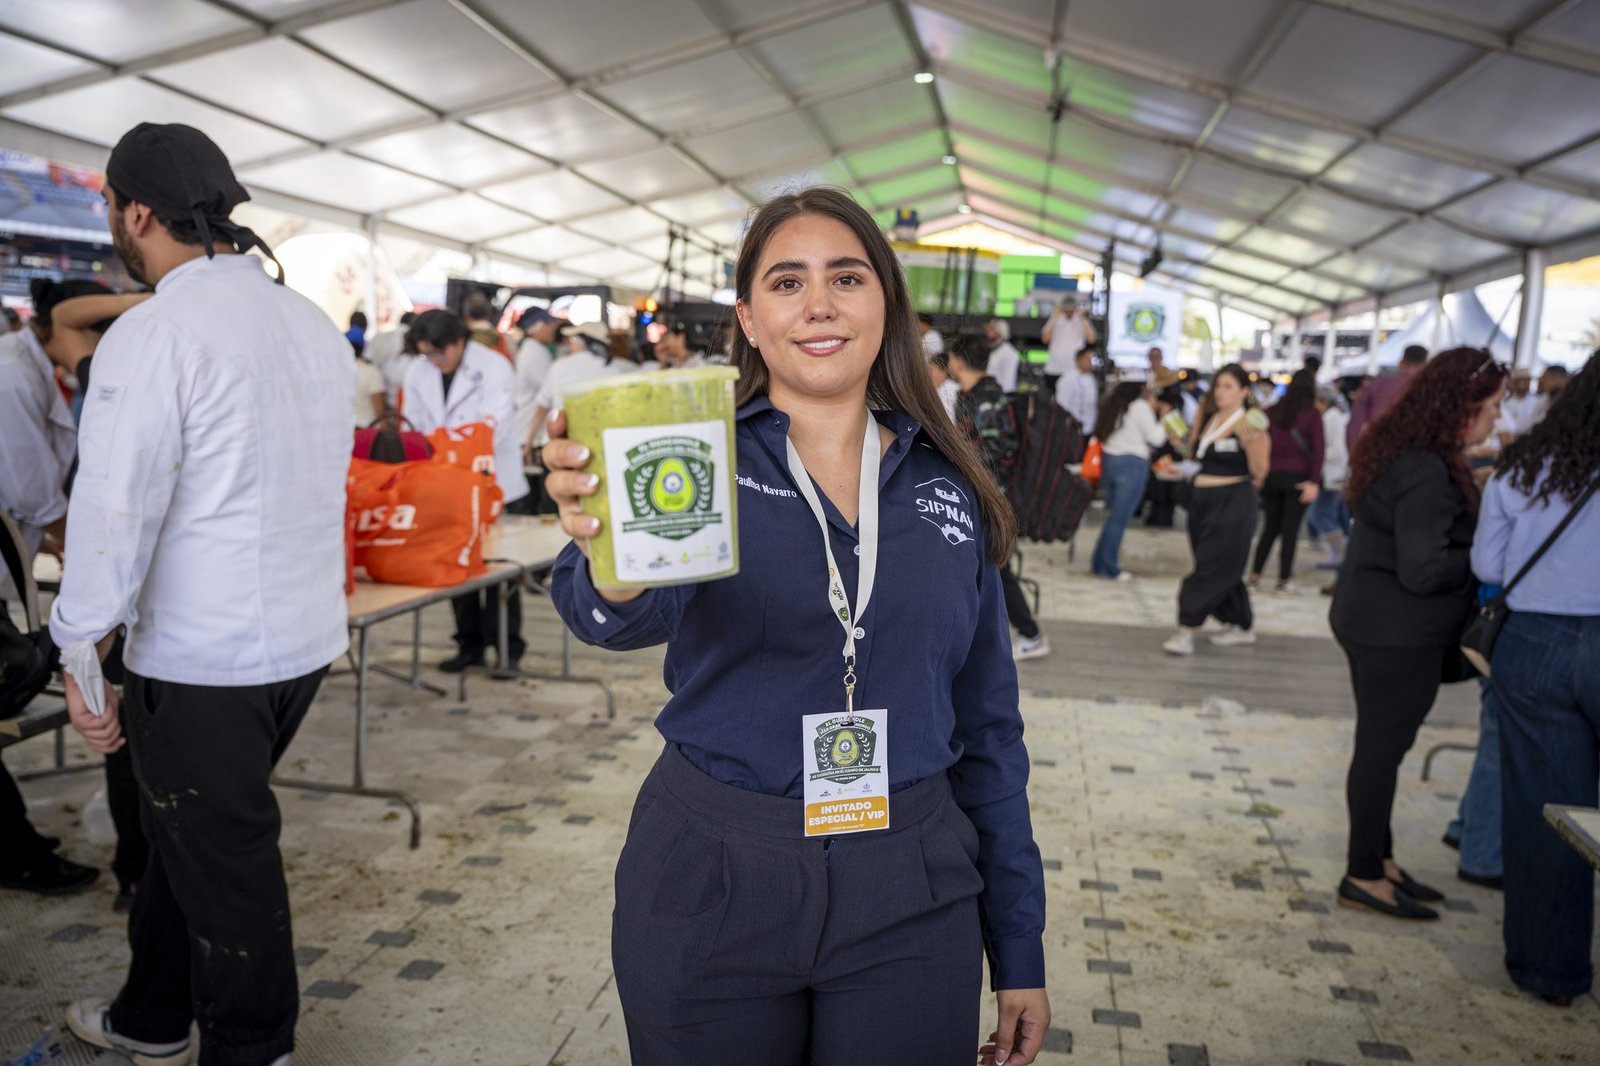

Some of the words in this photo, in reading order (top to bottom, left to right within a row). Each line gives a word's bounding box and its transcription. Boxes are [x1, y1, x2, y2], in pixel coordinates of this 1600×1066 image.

[762, 484, 797, 498] Navarro
[821, 801, 872, 814] INVITADO
[808, 813, 858, 826] ESPECIAL
[859, 811, 865, 820] /
[867, 810, 885, 820] VIP
